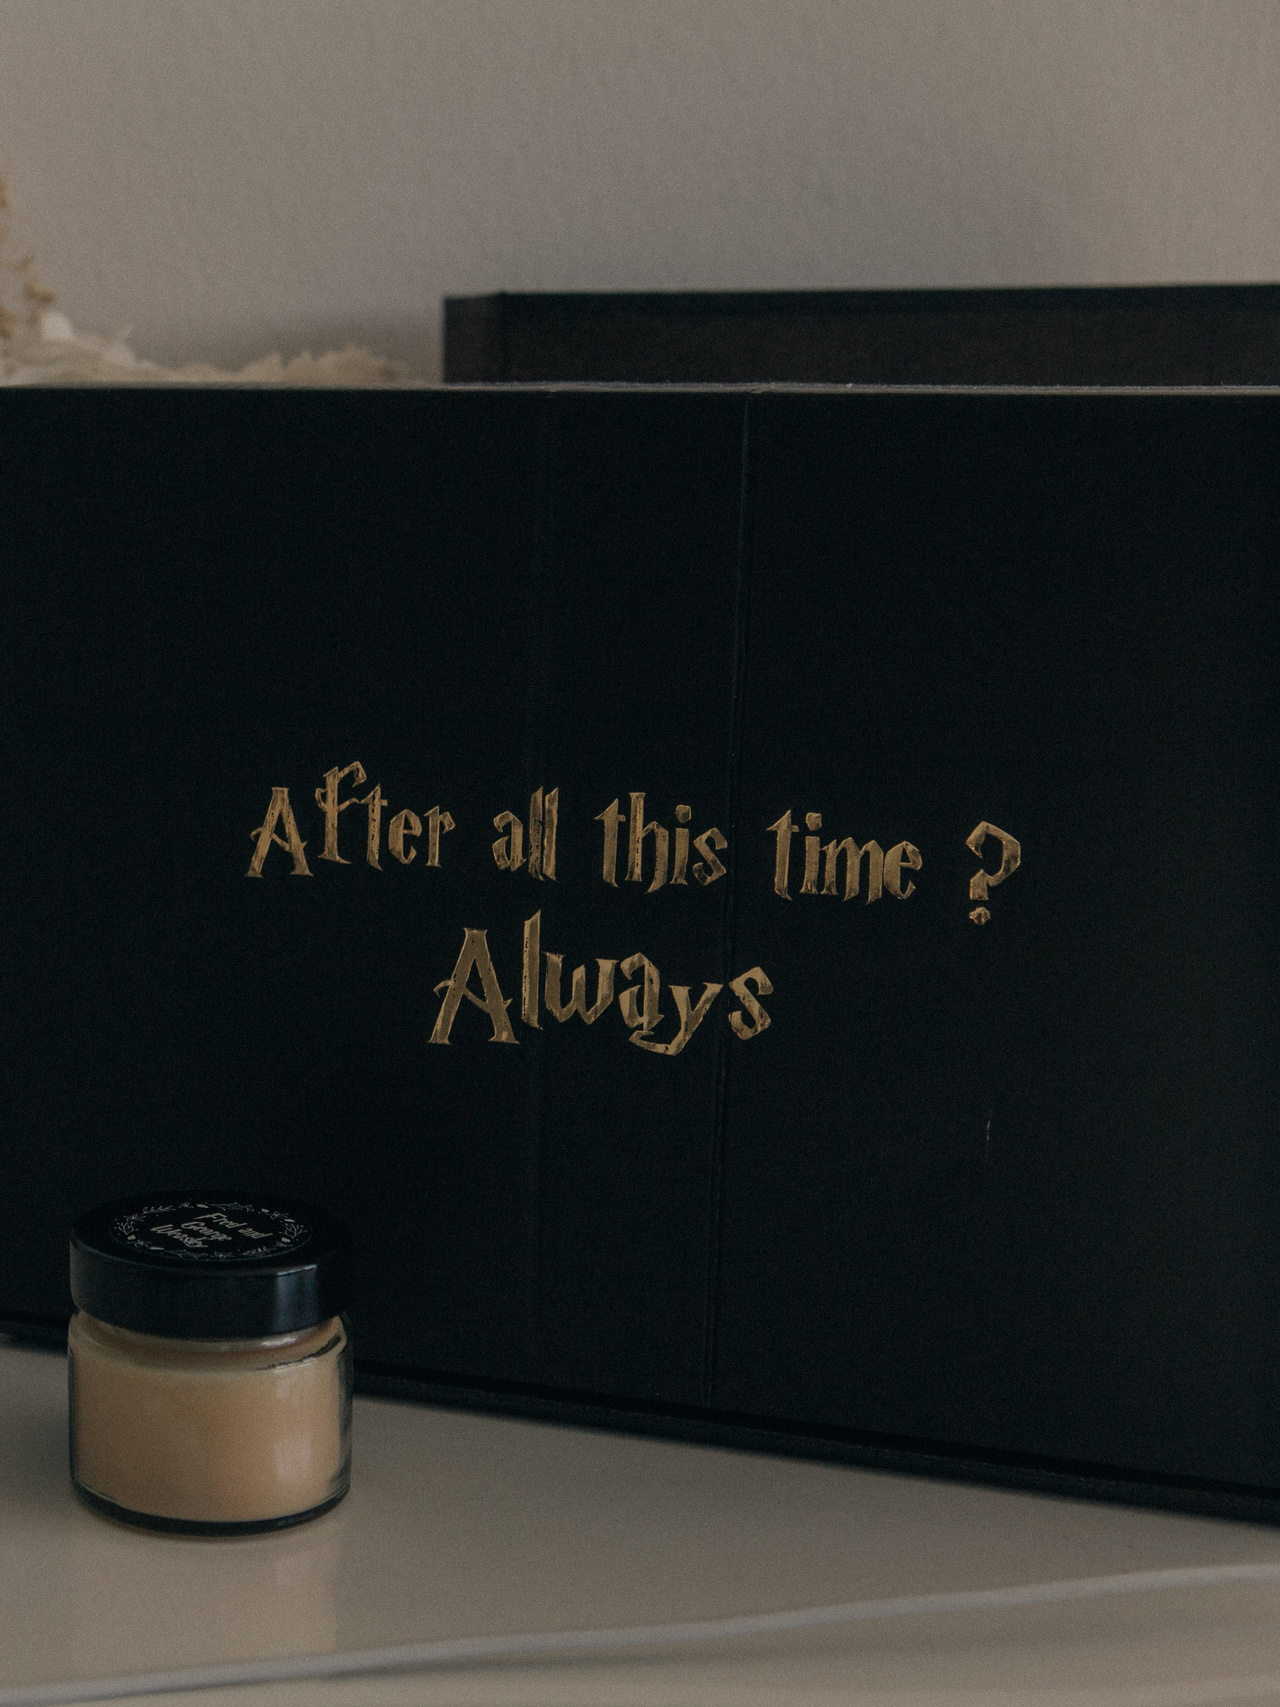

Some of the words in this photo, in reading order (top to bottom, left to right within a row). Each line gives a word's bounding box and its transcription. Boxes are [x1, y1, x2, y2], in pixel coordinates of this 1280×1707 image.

[244, 760, 456, 878] After
[491, 785, 560, 882] all
[594, 791, 729, 894] this
[765, 808, 924, 904] time
[965, 820, 1023, 926] ?
[427, 909, 775, 1057] Always
[193, 1212, 248, 1229] Fred
[237, 1227, 274, 1239] and
